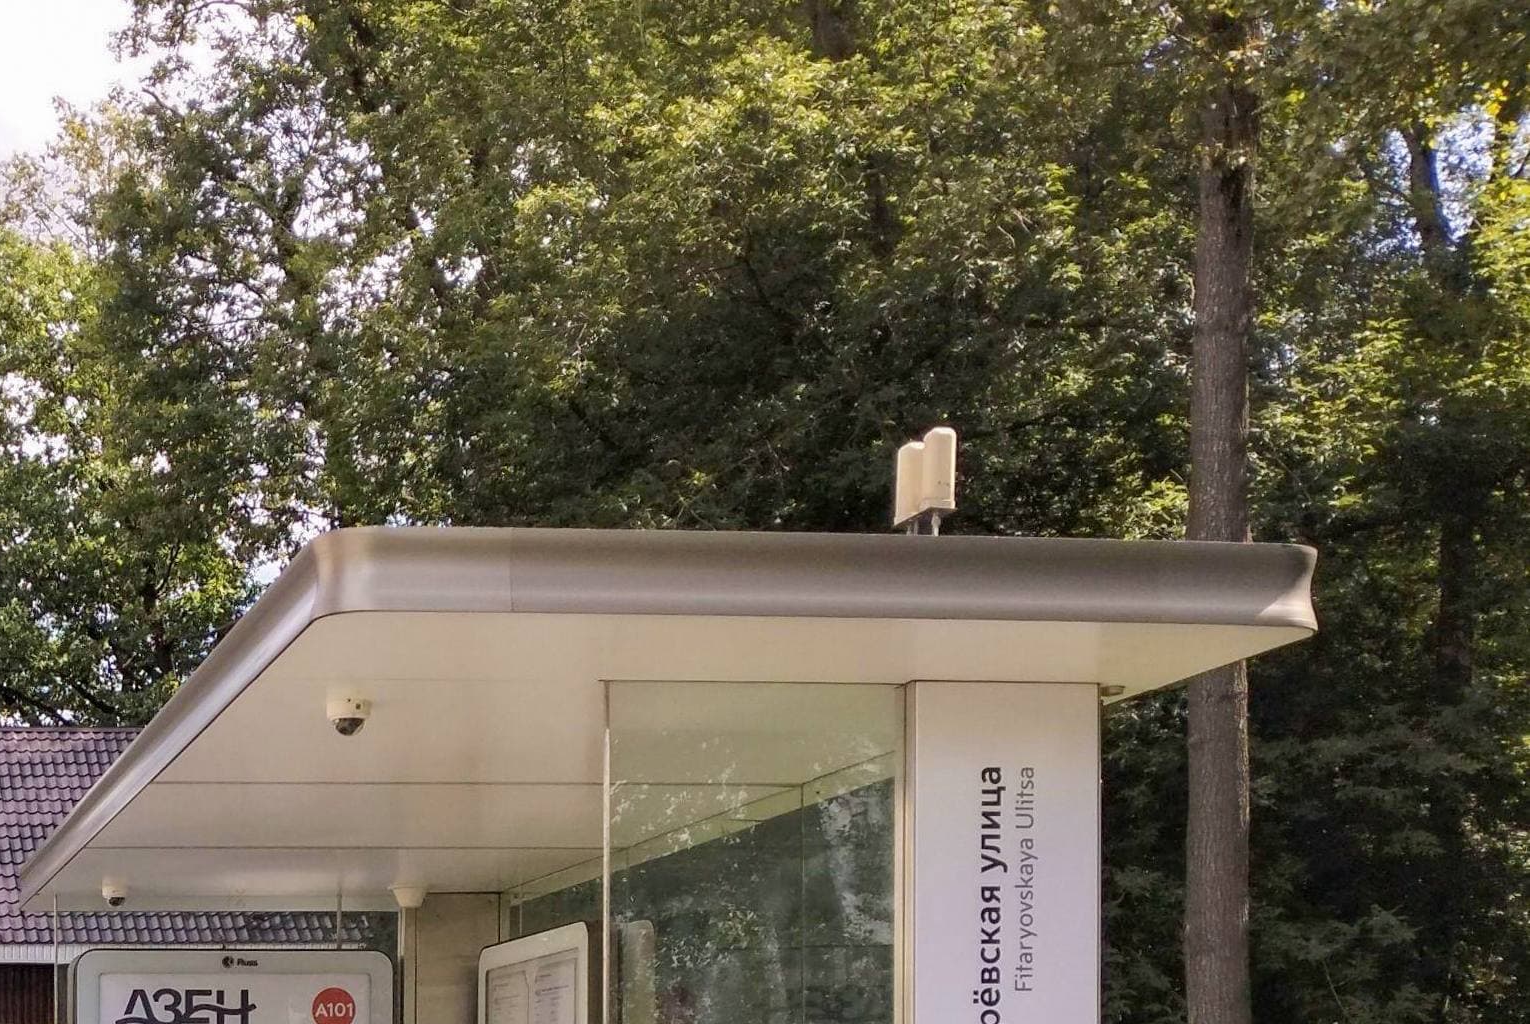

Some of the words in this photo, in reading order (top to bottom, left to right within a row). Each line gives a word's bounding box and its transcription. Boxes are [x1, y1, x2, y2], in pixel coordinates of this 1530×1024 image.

[980, 766, 1008, 874] улица
[1015, 766, 1036, 829] Ulitsa
[1014, 837, 1039, 992] Fitaryovskaya
